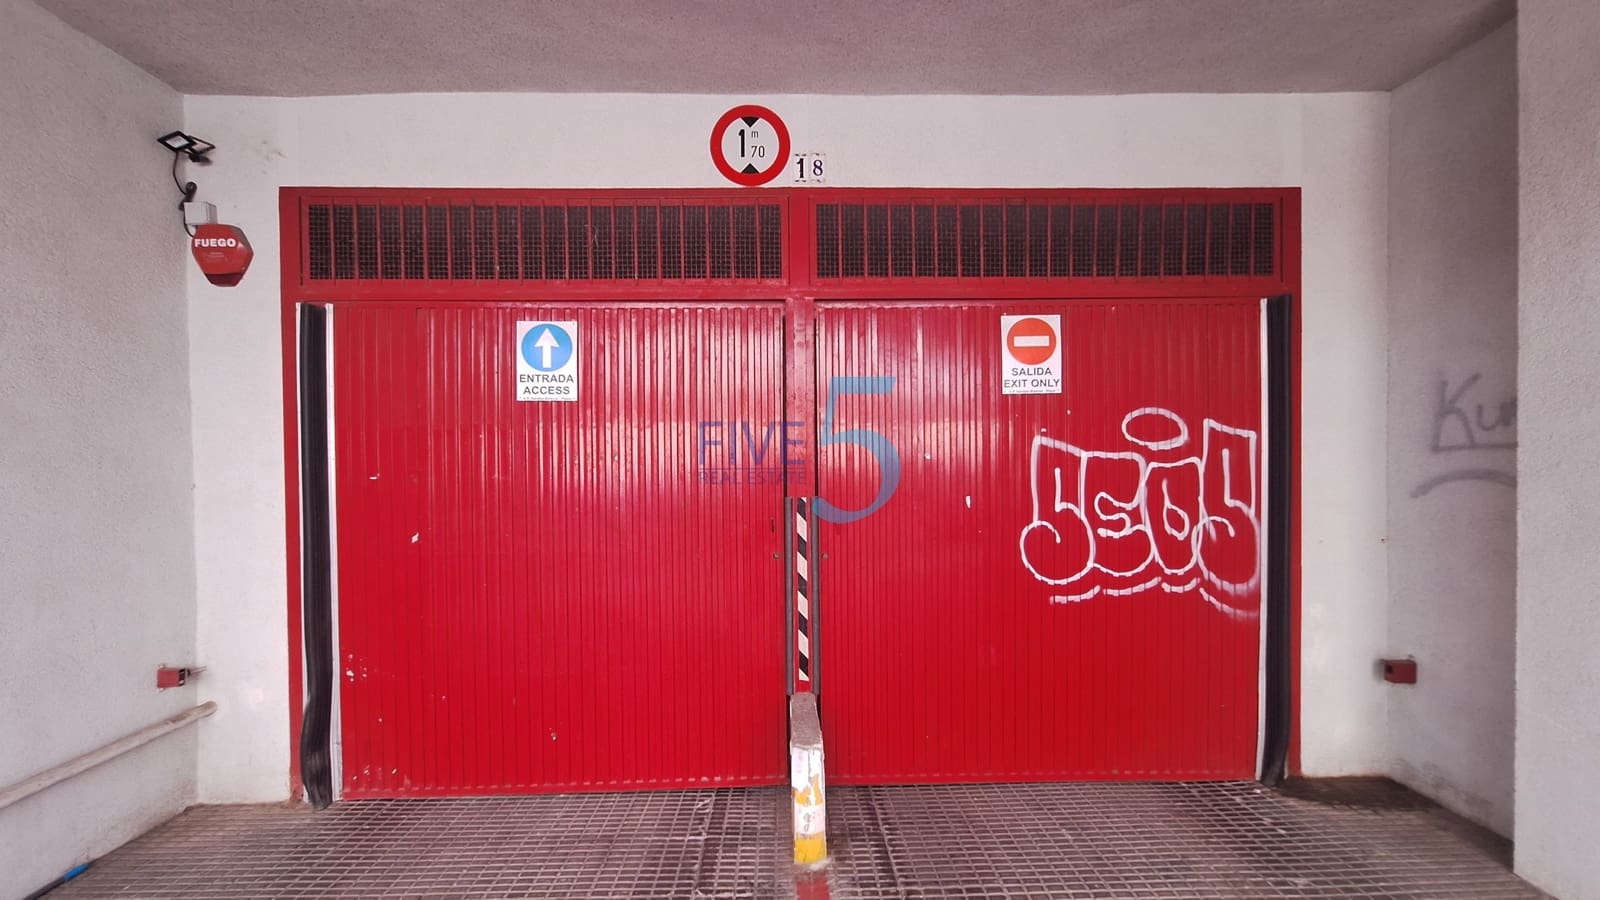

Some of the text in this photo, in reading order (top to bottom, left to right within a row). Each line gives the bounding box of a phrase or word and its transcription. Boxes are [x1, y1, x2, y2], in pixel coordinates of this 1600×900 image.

[738, 129, 746, 158] 1
[751, 146, 765, 158] 70
[796, 158, 823, 178] 18
[194, 238, 236, 247] FUEGO
[1011, 367, 1052, 376] SALIDA
[519, 374, 574, 383] ENTRADA
[1003, 379, 1060, 388] EXIT ONLY
[523, 386, 570, 395] ACCESS
